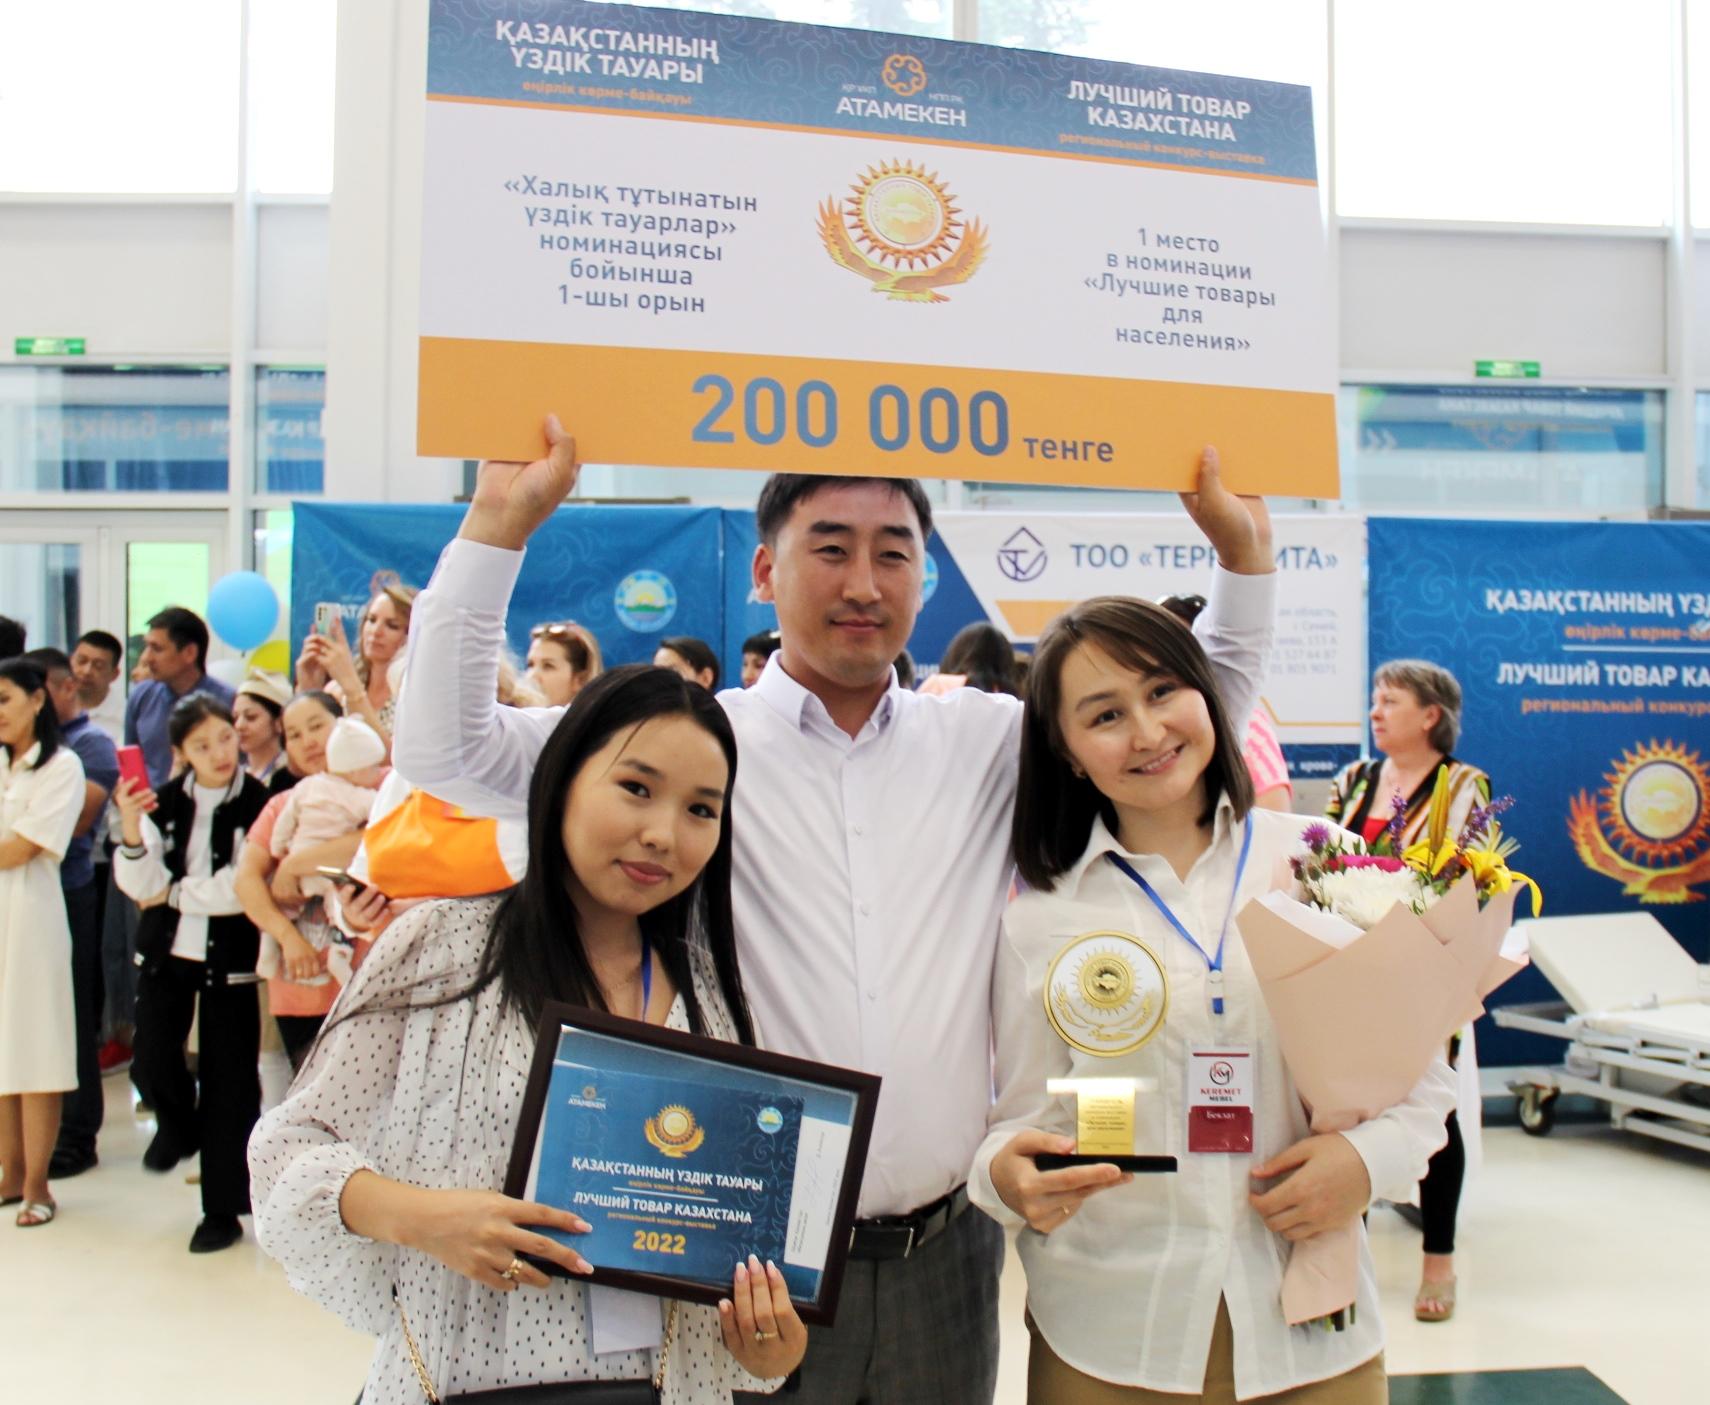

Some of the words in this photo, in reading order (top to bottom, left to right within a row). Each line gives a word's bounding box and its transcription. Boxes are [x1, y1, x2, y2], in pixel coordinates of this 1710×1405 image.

[495, 19, 720, 65] ҚАЗАҚСТАННЫҢ
[510, 46, 592, 76] ҮЗДІК
[597, 54, 704, 84] ТАУАРЫ
[836, 96, 967, 127] АТАМЕКЕН
[1067, 80, 1173, 111] ЛУЧШИЙ
[1177, 93, 1251, 120] ТОВАР
[1087, 105, 1237, 142] КАЗАХСТАНА
[503, 174, 610, 204] «Халық
[616, 185, 758, 212] тұтынатын
[525, 204, 593, 227] үздік
[600, 210, 737, 239] тауарлар»
[539, 234, 723, 262] номинациясы
[1138, 228, 1147, 246] 1
[1156, 233, 1220, 253] место
[569, 257, 693, 286] бойынша
[1107, 253, 1118, 267] в
[1126, 255, 1252, 281] номинации
[558, 284, 629, 308] 1-шы
[637, 293, 705, 315] орын
[1084, 273, 1190, 298] «Лучшие
[1195, 285, 1276, 309] товары
[1162, 307, 1203, 325] для
[1116, 327, 1251, 351] населения»
[691, 374, 838, 448] 200
[868, 383, 1010, 457] 000
[1023, 436, 1114, 463] тенге
[1070, 544, 1129, 568] ТОО
[1485, 588, 1675, 618] ҚАЗАҚСТАННЫҢ
[1496, 659, 1600, 686] ЛУЧШИЙ
[1603, 664, 1678, 687] ТОВАР
[1521, 697, 1644, 715] региональный
[571, 1156, 675, 1183] ҚАЗАҚСТАННЫҢ
[677, 1169, 714, 1186] ҮЗДІК
[715, 1173, 764, 1192] ТАУАРЫ
[573, 1191, 630, 1210] ЛУЧШИЙ
[632, 1198, 673, 1214] ТОВАР
[674, 1203, 753, 1224] КАЗАХСТАНА
[632, 1229, 687, 1255] 2022
